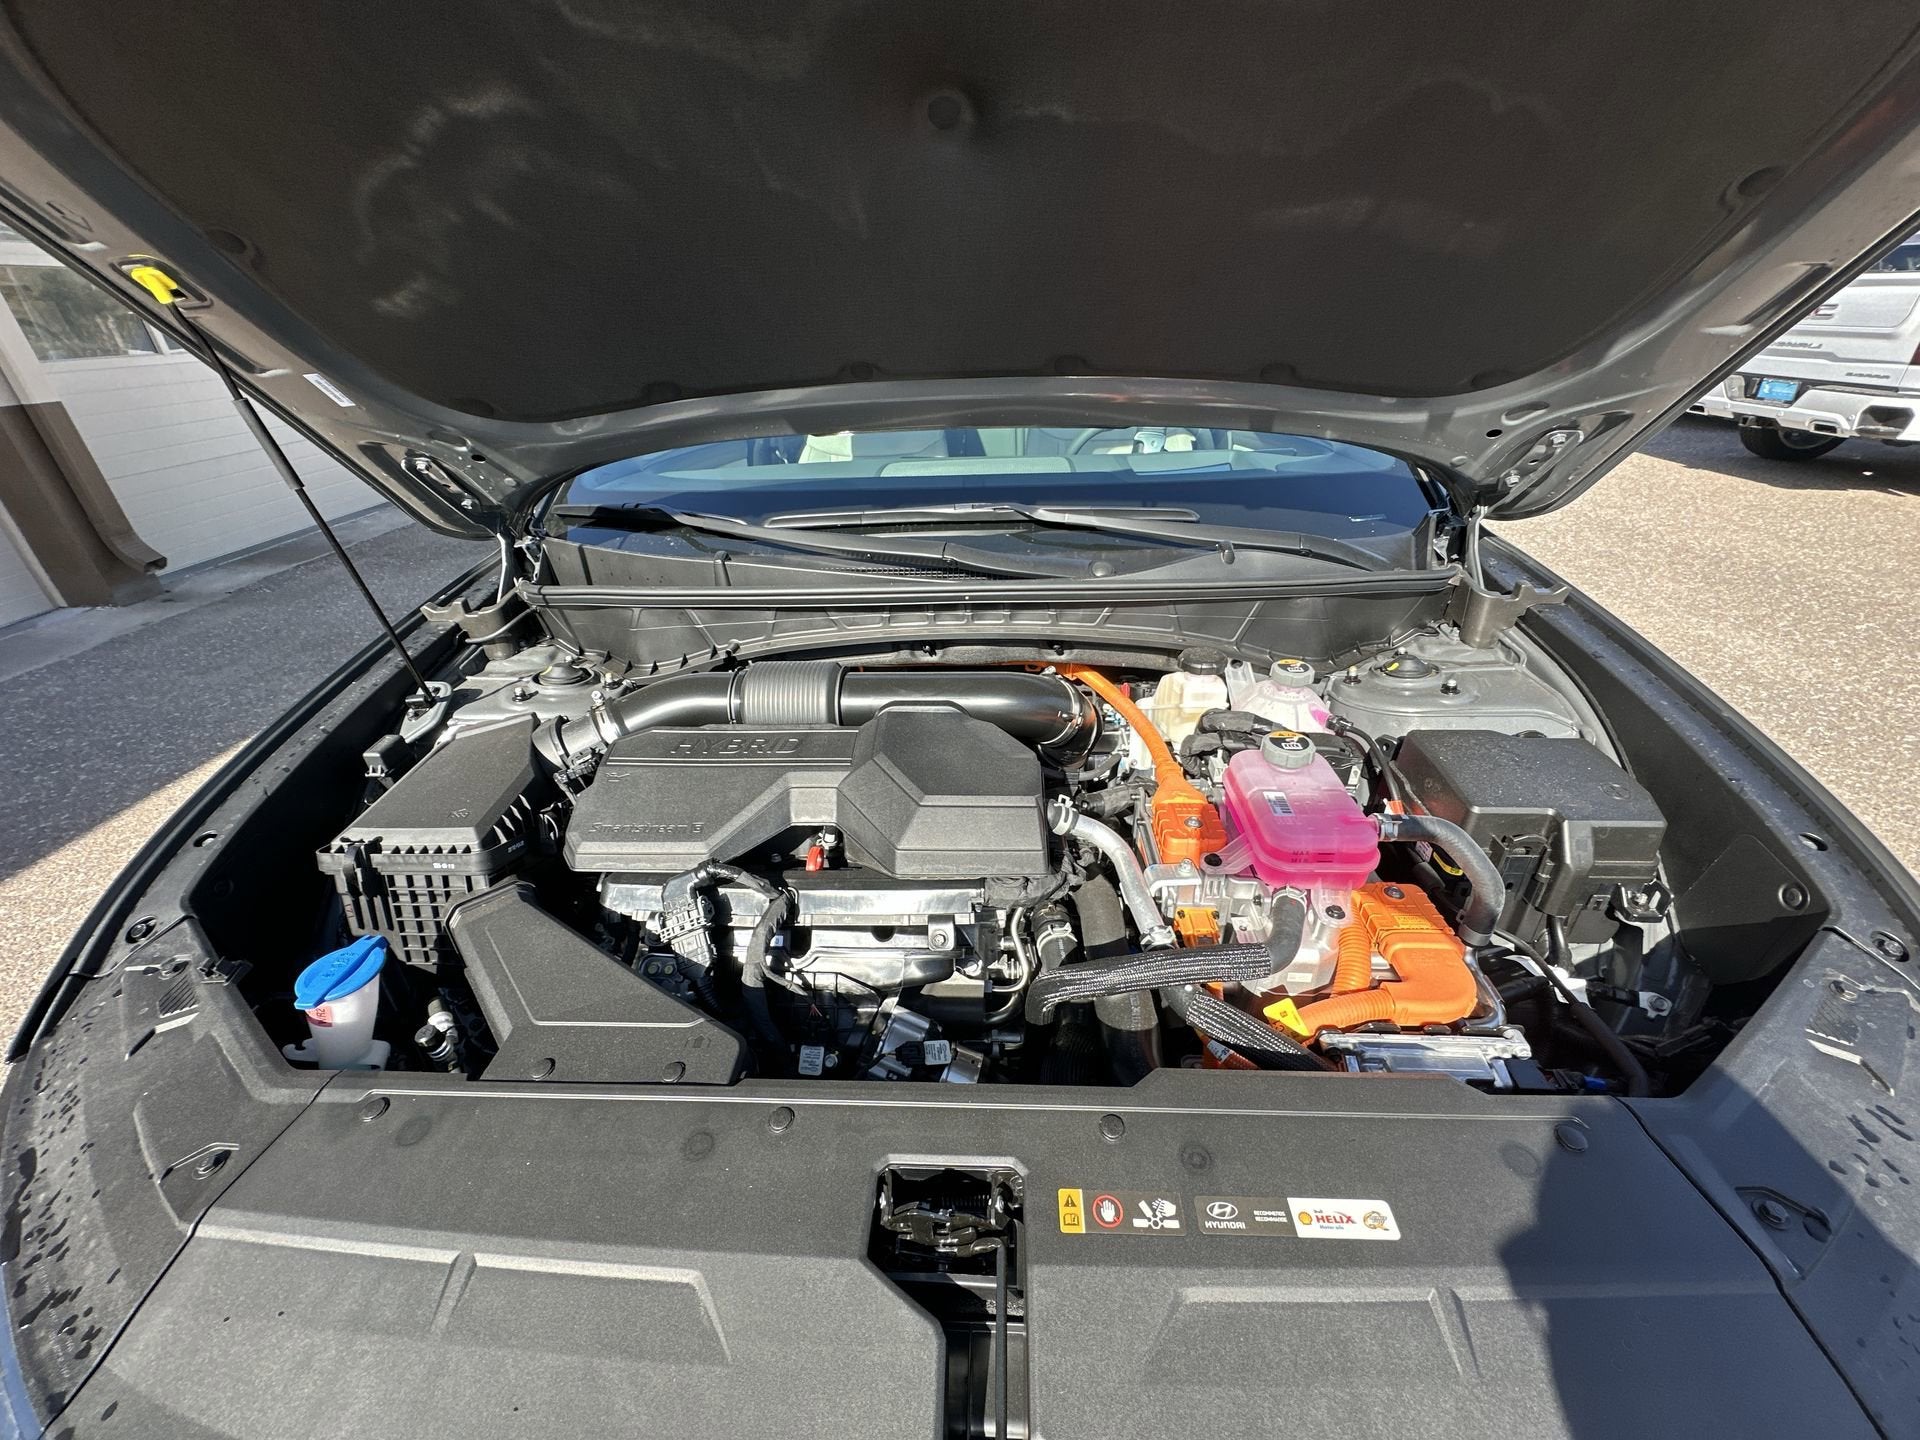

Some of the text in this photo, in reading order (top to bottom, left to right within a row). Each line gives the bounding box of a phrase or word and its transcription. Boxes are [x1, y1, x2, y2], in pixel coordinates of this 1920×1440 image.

[669, 736, 800, 754] HYBRID
[588, 821, 704, 833] Smartstream G
[1204, 1220, 1246, 1230] HYUNDAI
[1315, 1214, 1356, 1225] HELIX
